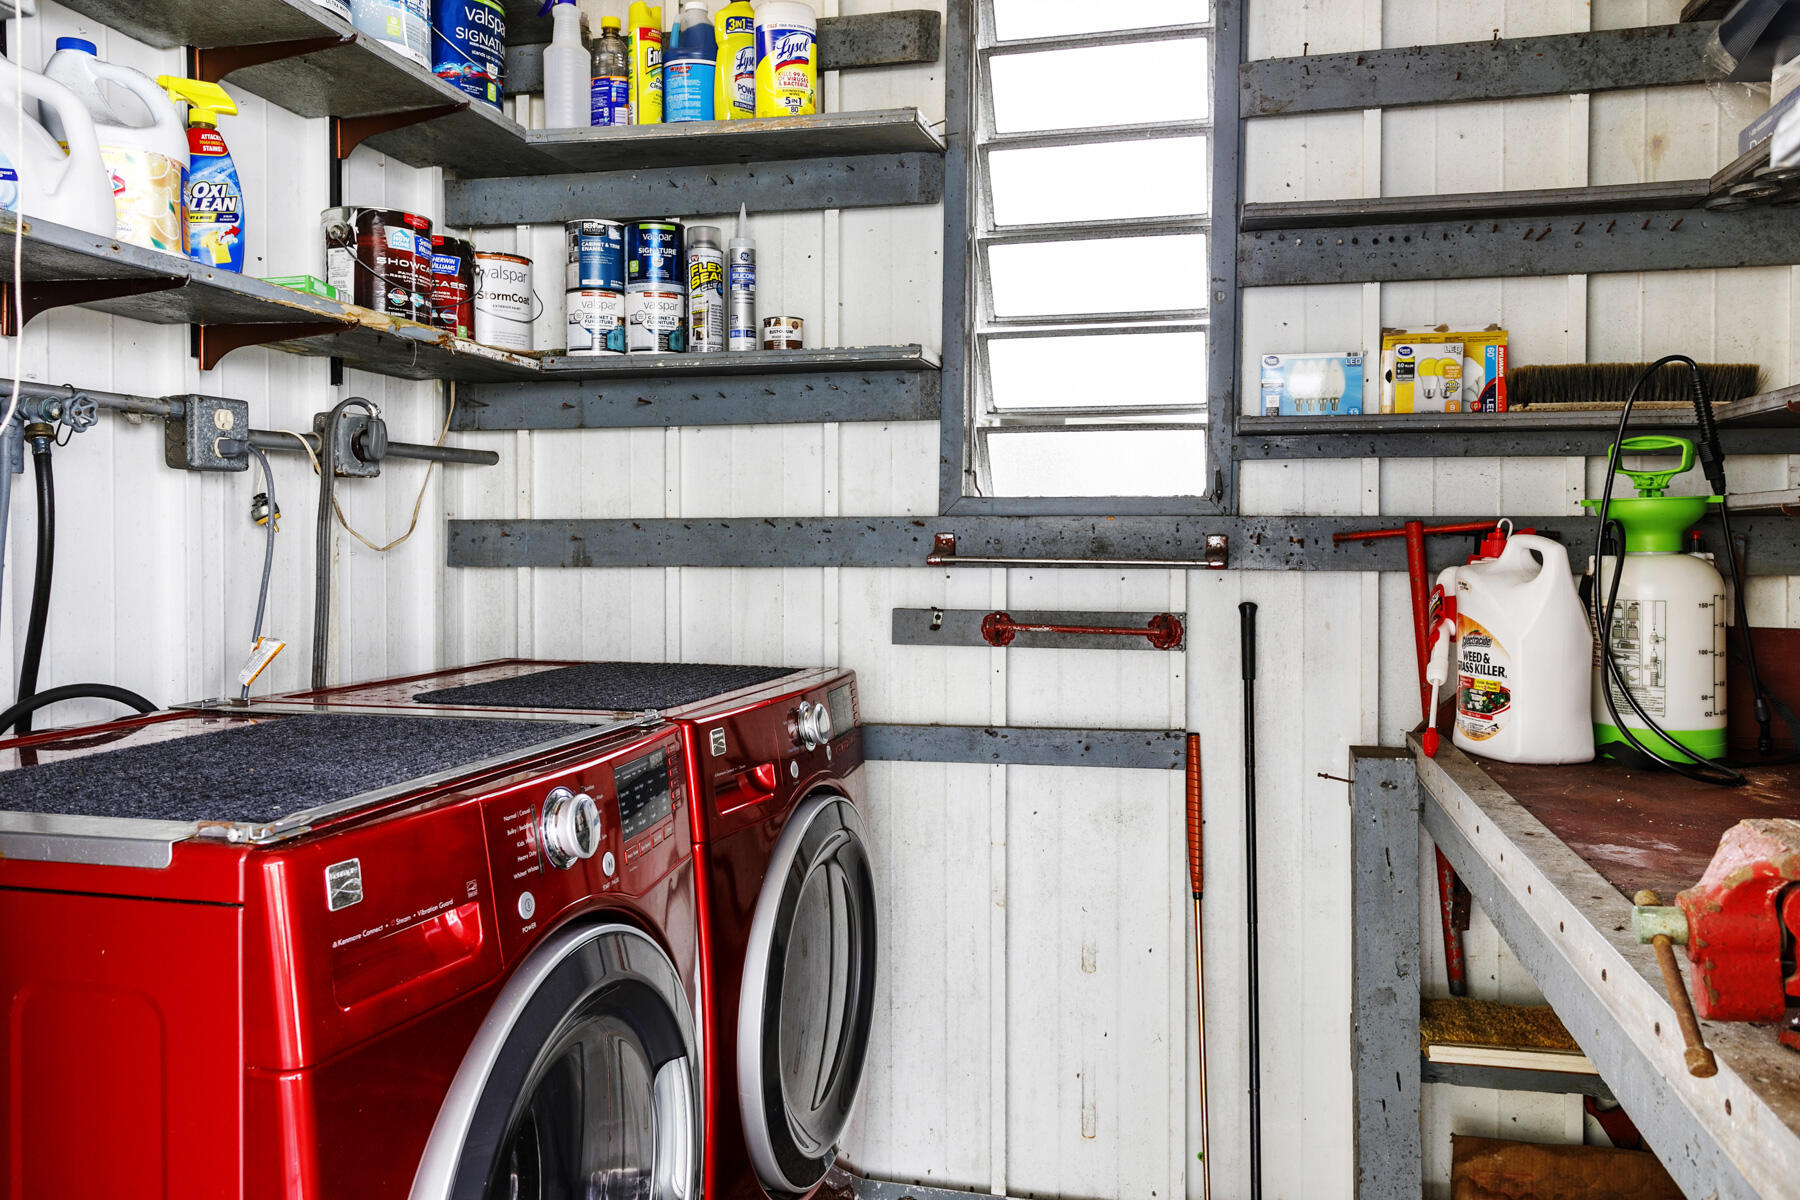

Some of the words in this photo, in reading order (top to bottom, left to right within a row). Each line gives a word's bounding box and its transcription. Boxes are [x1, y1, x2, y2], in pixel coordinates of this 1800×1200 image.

[777, 38, 810, 59] Lysol
[192, 182, 228, 198] OXI
[190, 197, 237, 211] LEAN
[432, 255, 456, 264] HERWIN
[482, 265, 527, 284] valspar
[691, 262, 722, 278] FLEX
[691, 273, 722, 290] SEAL
[478, 290, 530, 305] StormCoat
[581, 299, 617, 312] vaspar
[644, 299, 679, 312] vaspar
[646, 319, 676, 327] FUNITURE
[1444, 345, 1462, 353] LED
[1345, 358, 1362, 367] LED
[1463, 651, 1482, 663] WEED
[1483, 653, 1491, 664] &
[1474, 664, 1506, 679] KILLER
[337, 933, 362, 947] Kenmore
[362, 925, 384, 939] Connect
[395, 915, 412, 926] Steam
[416, 905, 438, 917] Vibration
[438, 899, 454, 910] Guard
[522, 921, 537, 934] POWER
